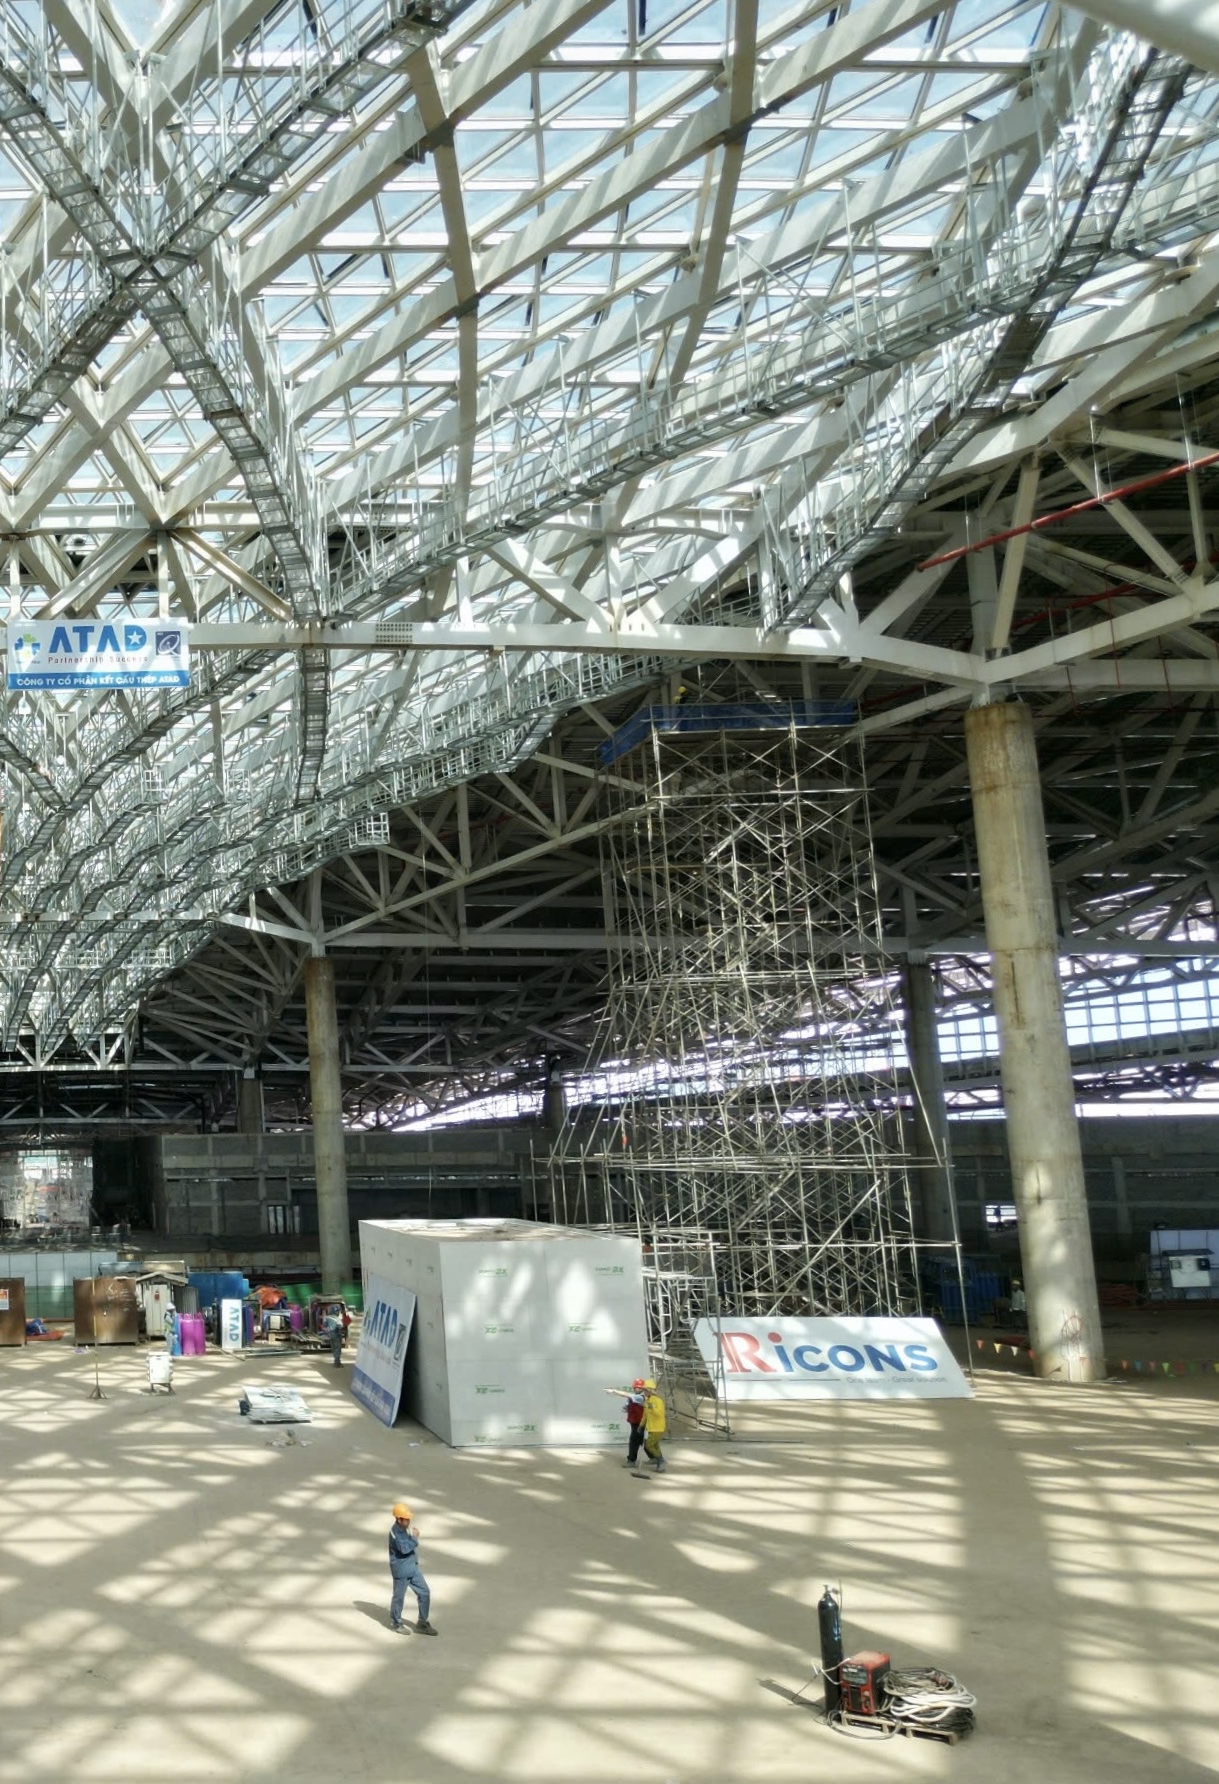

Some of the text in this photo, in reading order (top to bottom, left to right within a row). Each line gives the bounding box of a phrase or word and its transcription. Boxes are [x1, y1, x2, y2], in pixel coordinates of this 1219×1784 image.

[49, 625, 147, 653] ATAD
[17, 677, 43, 685] CÔNG
[159, 675, 180, 683] ATAD
[229, 1306, 240, 1341] ATAD
